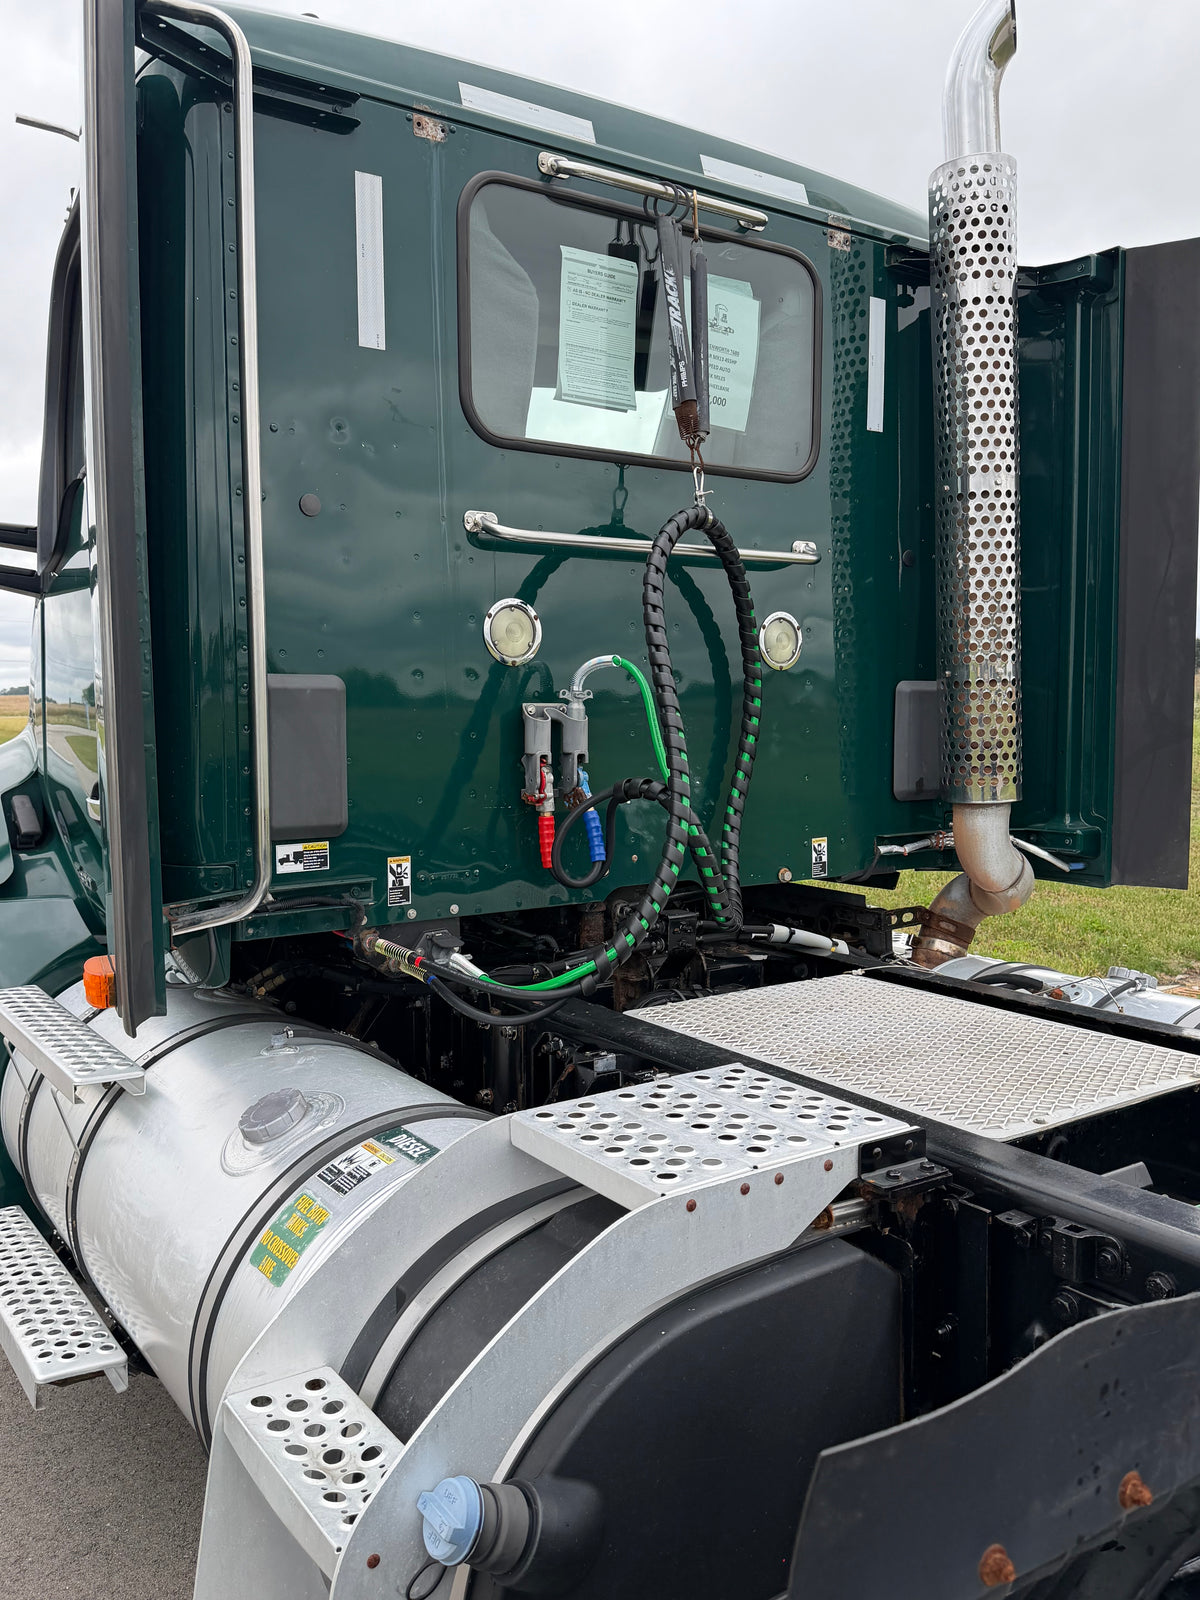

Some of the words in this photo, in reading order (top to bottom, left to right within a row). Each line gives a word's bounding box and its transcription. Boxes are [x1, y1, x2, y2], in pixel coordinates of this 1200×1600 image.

[587, 268, 603, 277] BUYERS
[606, 295, 626, 303] WARRANTY
[387, 1134, 430, 1158] DIESEL
[294, 1195, 314, 1215] FUEL
[306, 1204, 330, 1226] BOTH
[260, 1228, 273, 1246] NO
